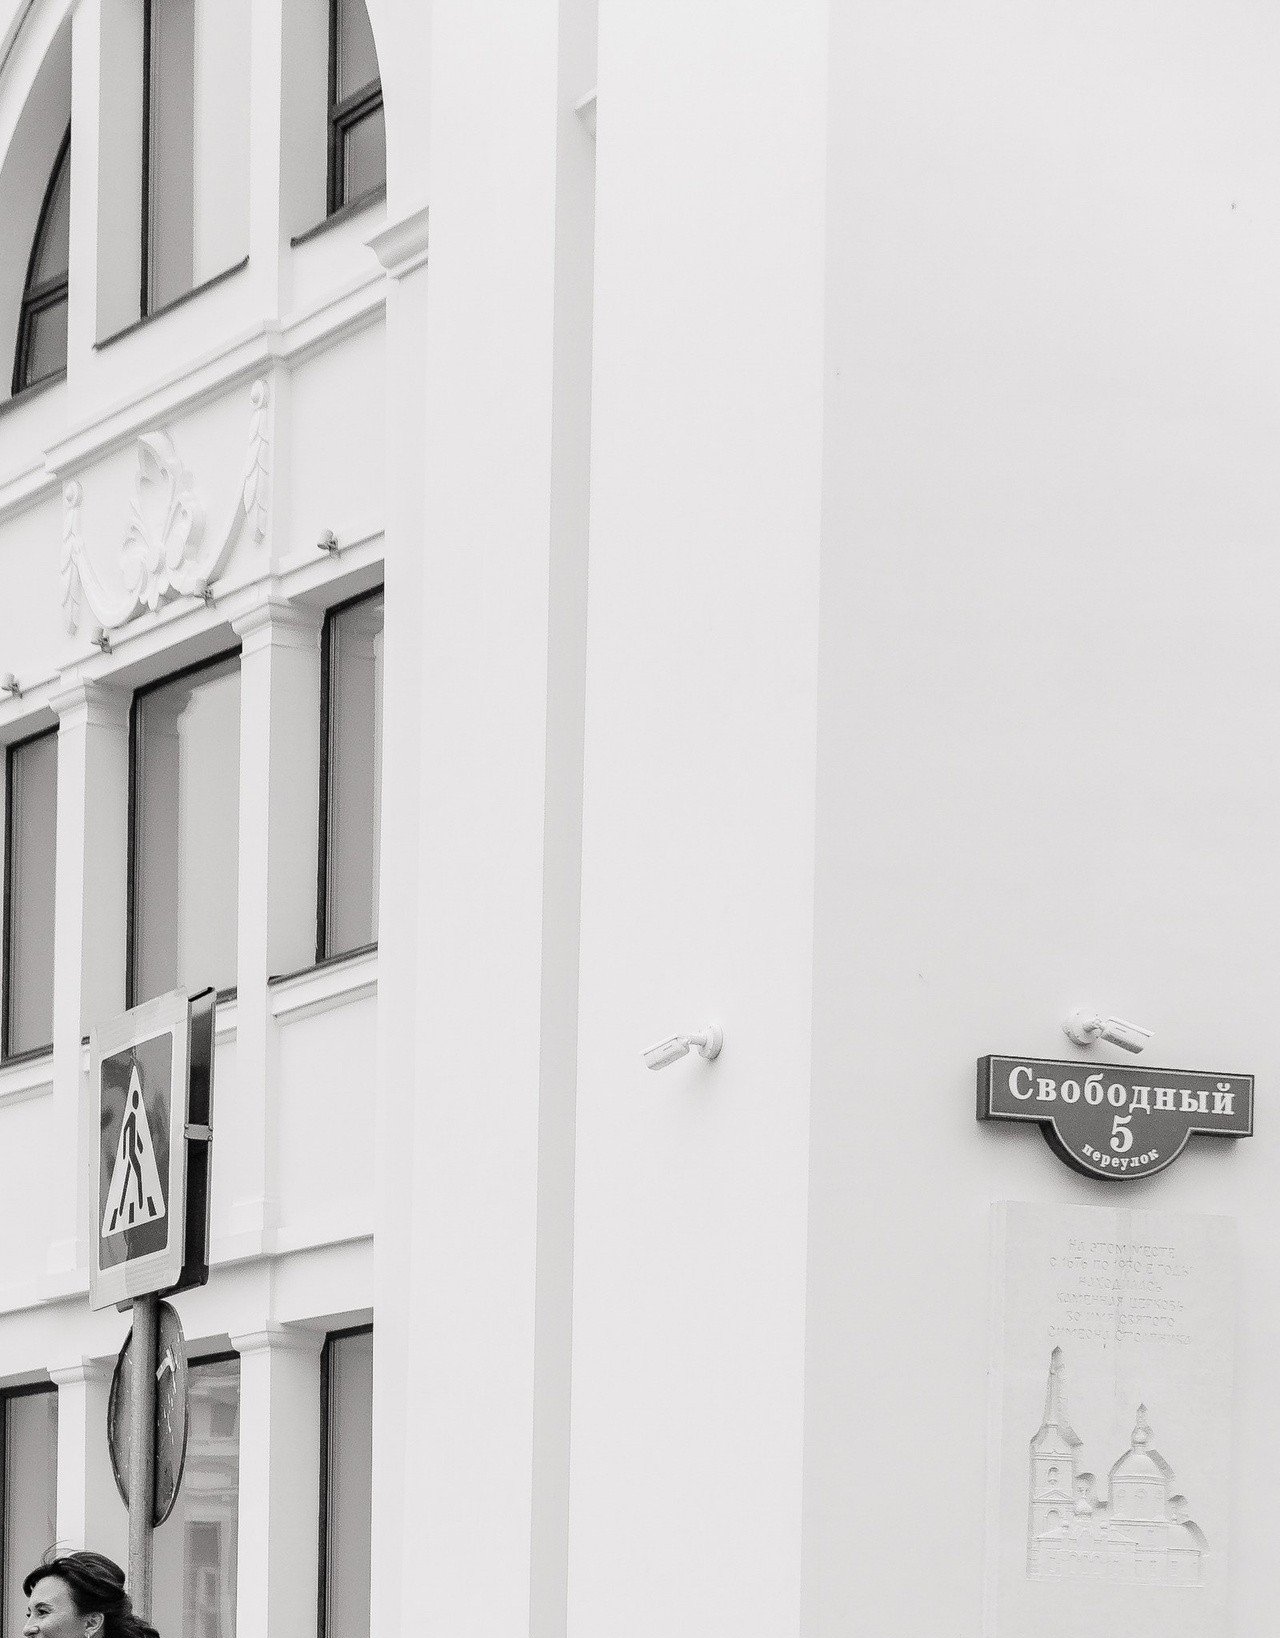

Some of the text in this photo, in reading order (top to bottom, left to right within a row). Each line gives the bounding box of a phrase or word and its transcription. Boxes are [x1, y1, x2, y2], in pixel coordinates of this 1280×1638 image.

[1008, 1066, 1235, 1115] Свободный
[1109, 1115, 1134, 1153] 5
[1082, 1143, 1159, 1170] переулок
[1089, 1241, 1127, 1255] ЭТОМ
[1131, 1244, 1176, 1259] МЕСТЕ
[1093, 1259, 1110, 1271] ПО
